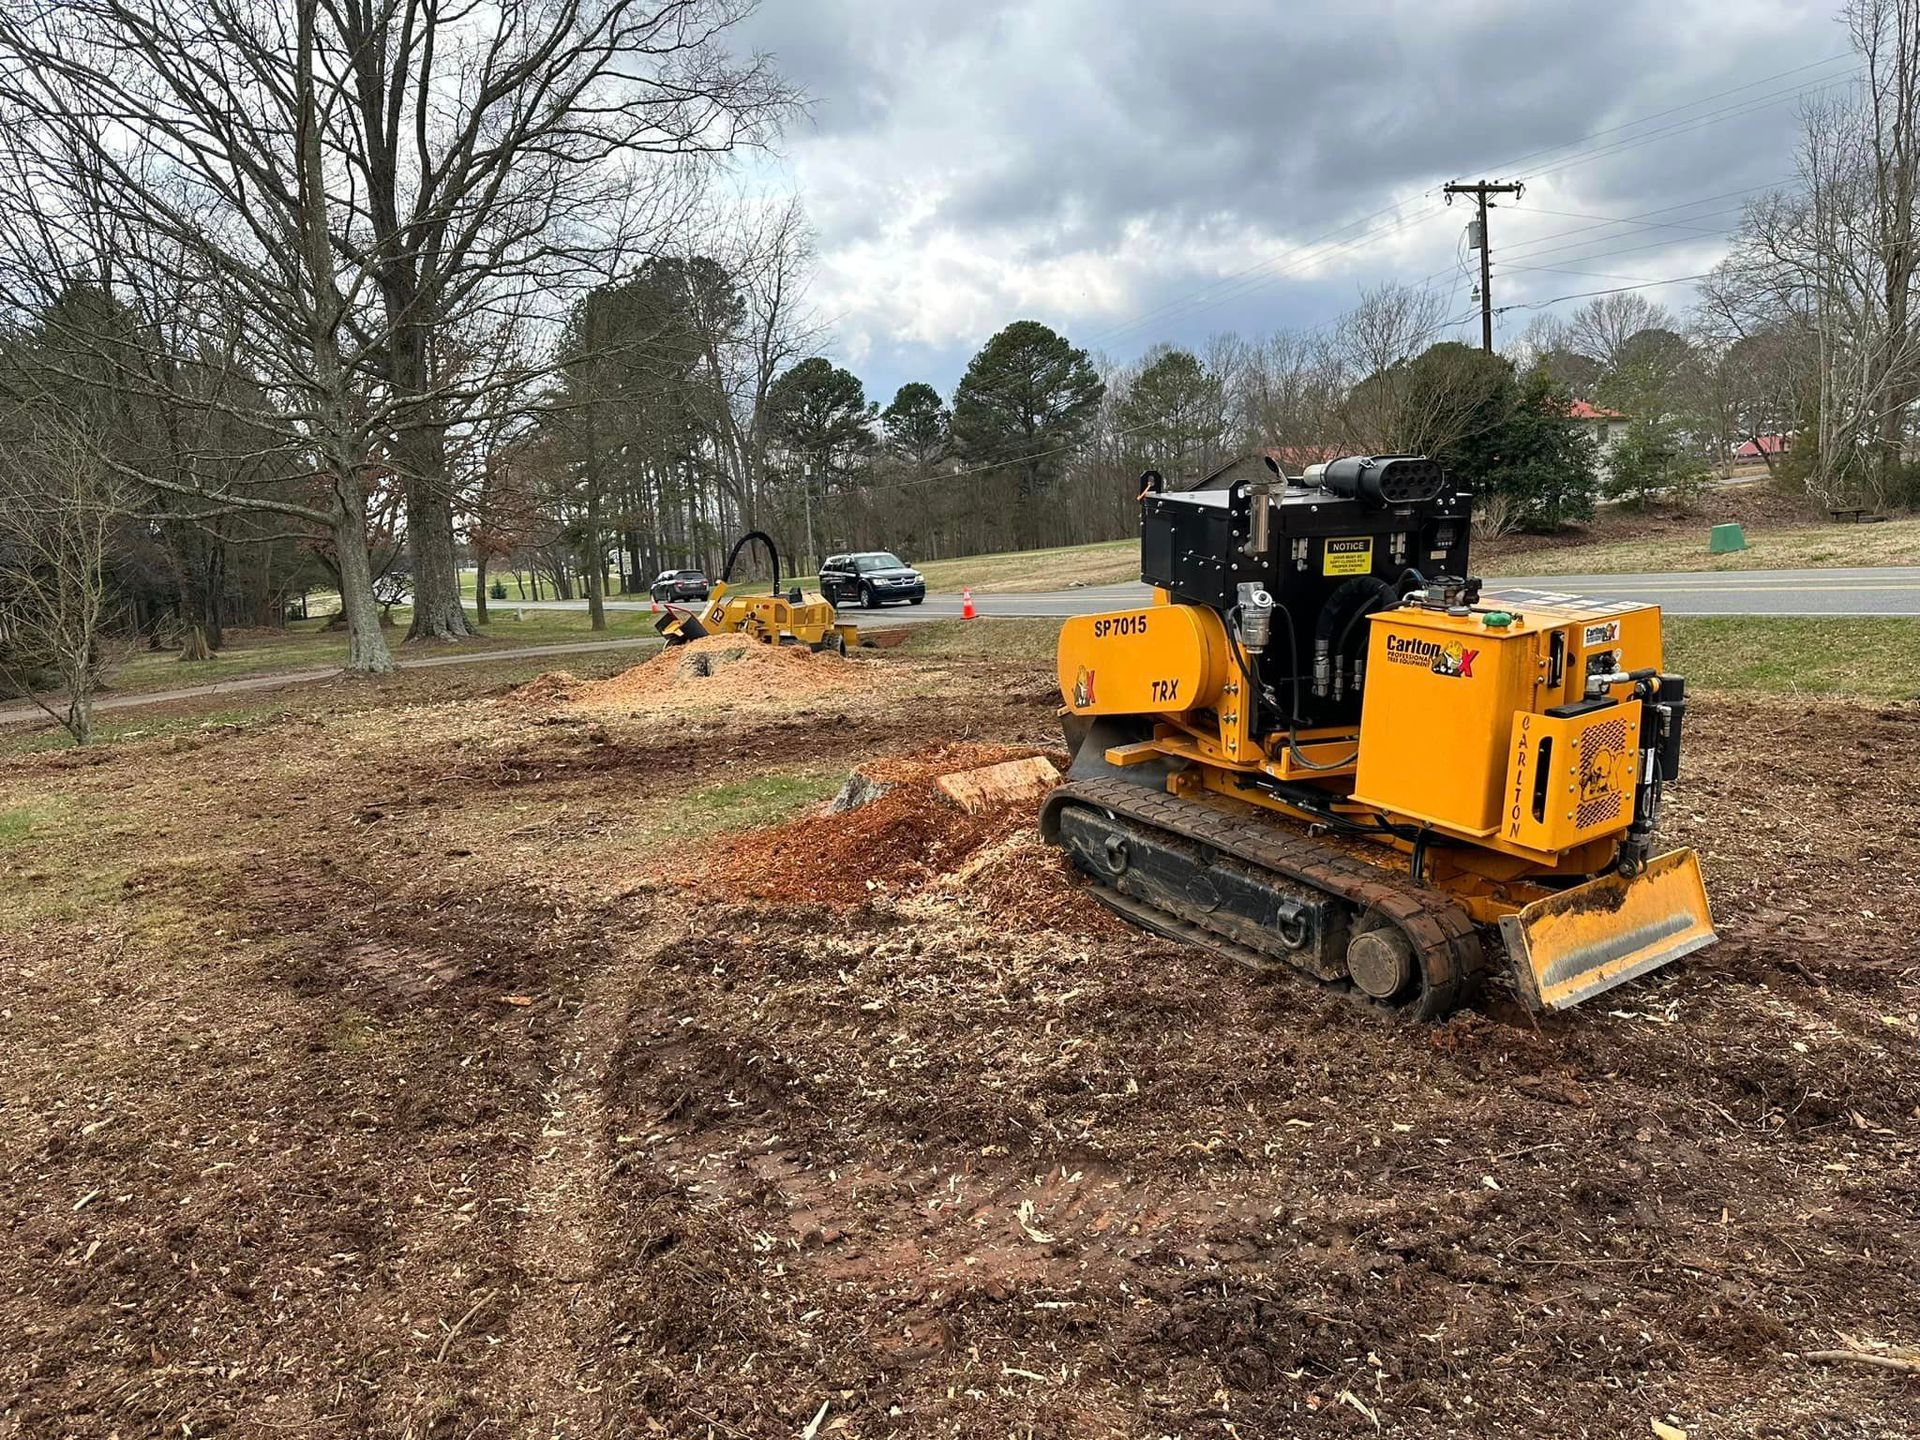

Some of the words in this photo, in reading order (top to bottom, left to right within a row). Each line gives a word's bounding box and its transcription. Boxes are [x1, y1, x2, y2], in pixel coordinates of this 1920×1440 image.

[1333, 542, 1364, 551] NOTICE
[1094, 615, 1147, 638] SP7015
[1387, 634, 1441, 657] Carlton
[1387, 650, 1431, 663] PROFESSIONAL
[1400, 658, 1430, 668] EQUIPMENT
[1151, 679, 1179, 703] TRX
[1509, 715, 1531, 839] CARLTON
